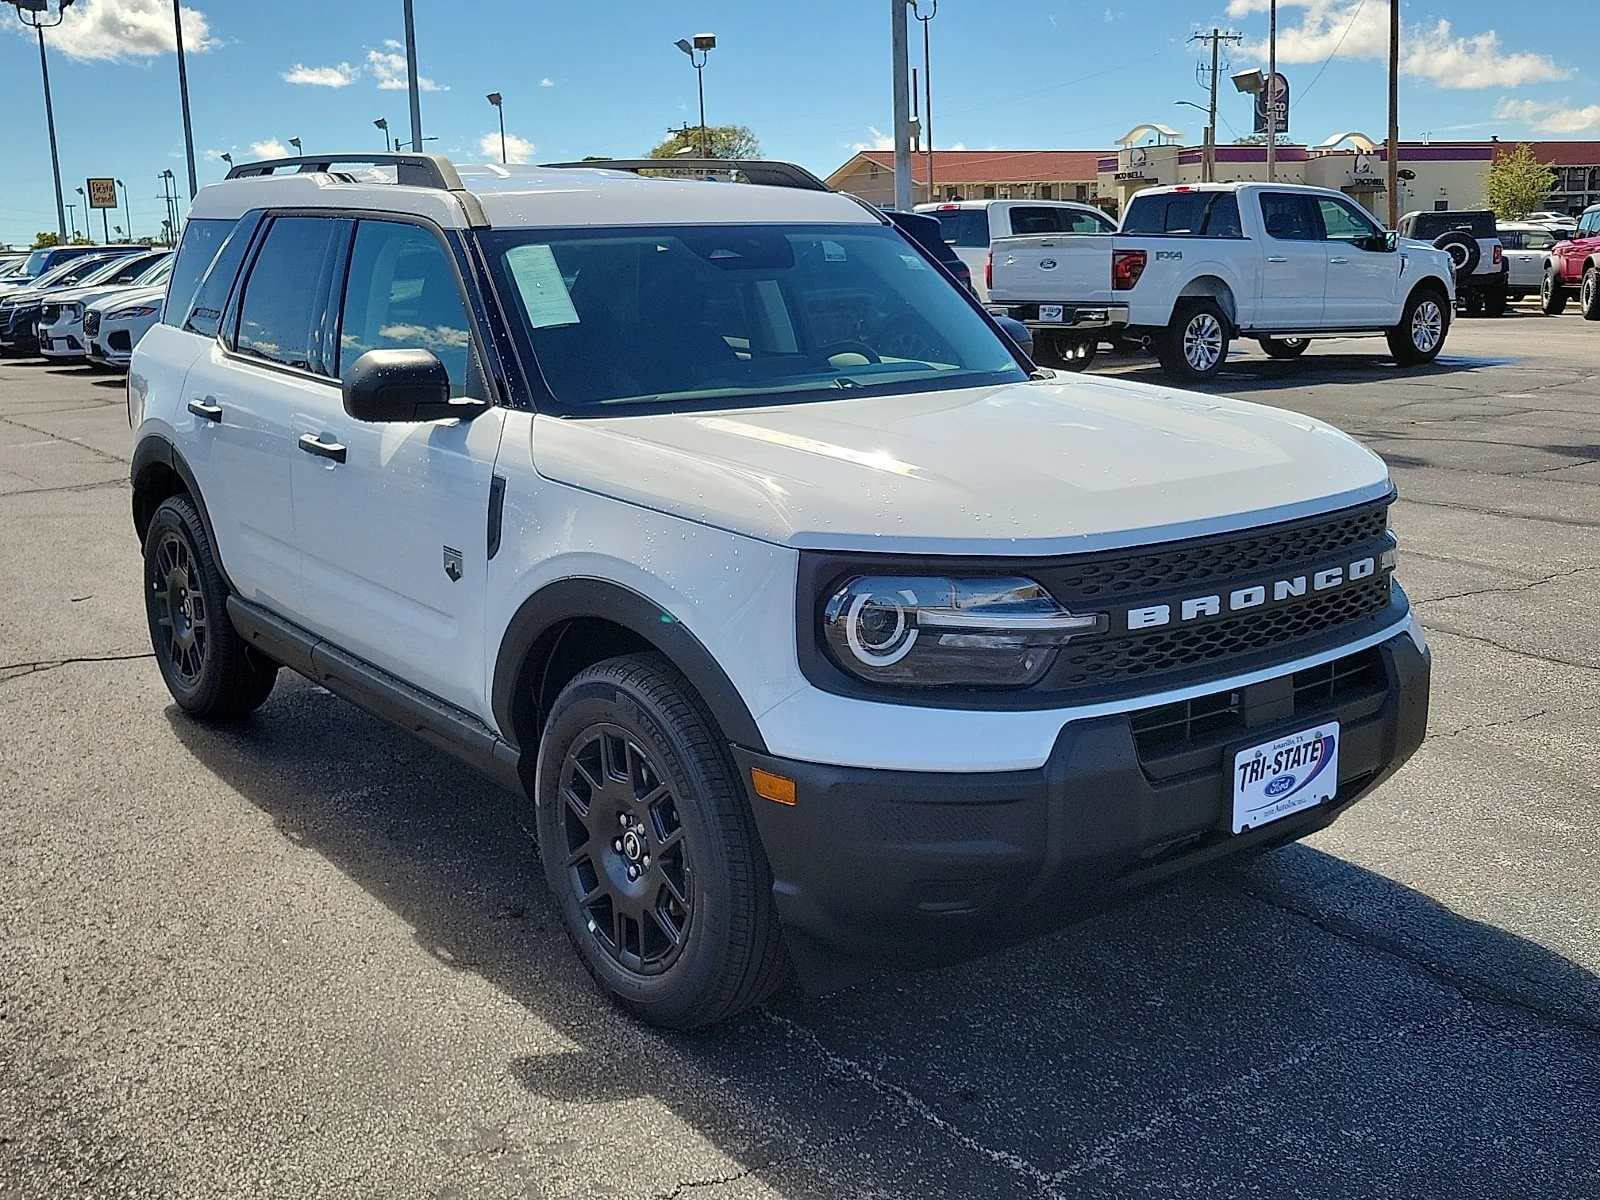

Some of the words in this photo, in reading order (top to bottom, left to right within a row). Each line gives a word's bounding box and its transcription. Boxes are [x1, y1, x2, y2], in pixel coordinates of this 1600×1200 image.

[1265, 102, 1285, 111] TCO
[1127, 170, 1144, 179] BELL
[1156, 251, 1183, 261] FX4
[1127, 557, 1375, 630] BRONCO
[1238, 738, 1322, 793] TRI-STATE
[1268, 777, 1292, 794] Ford
